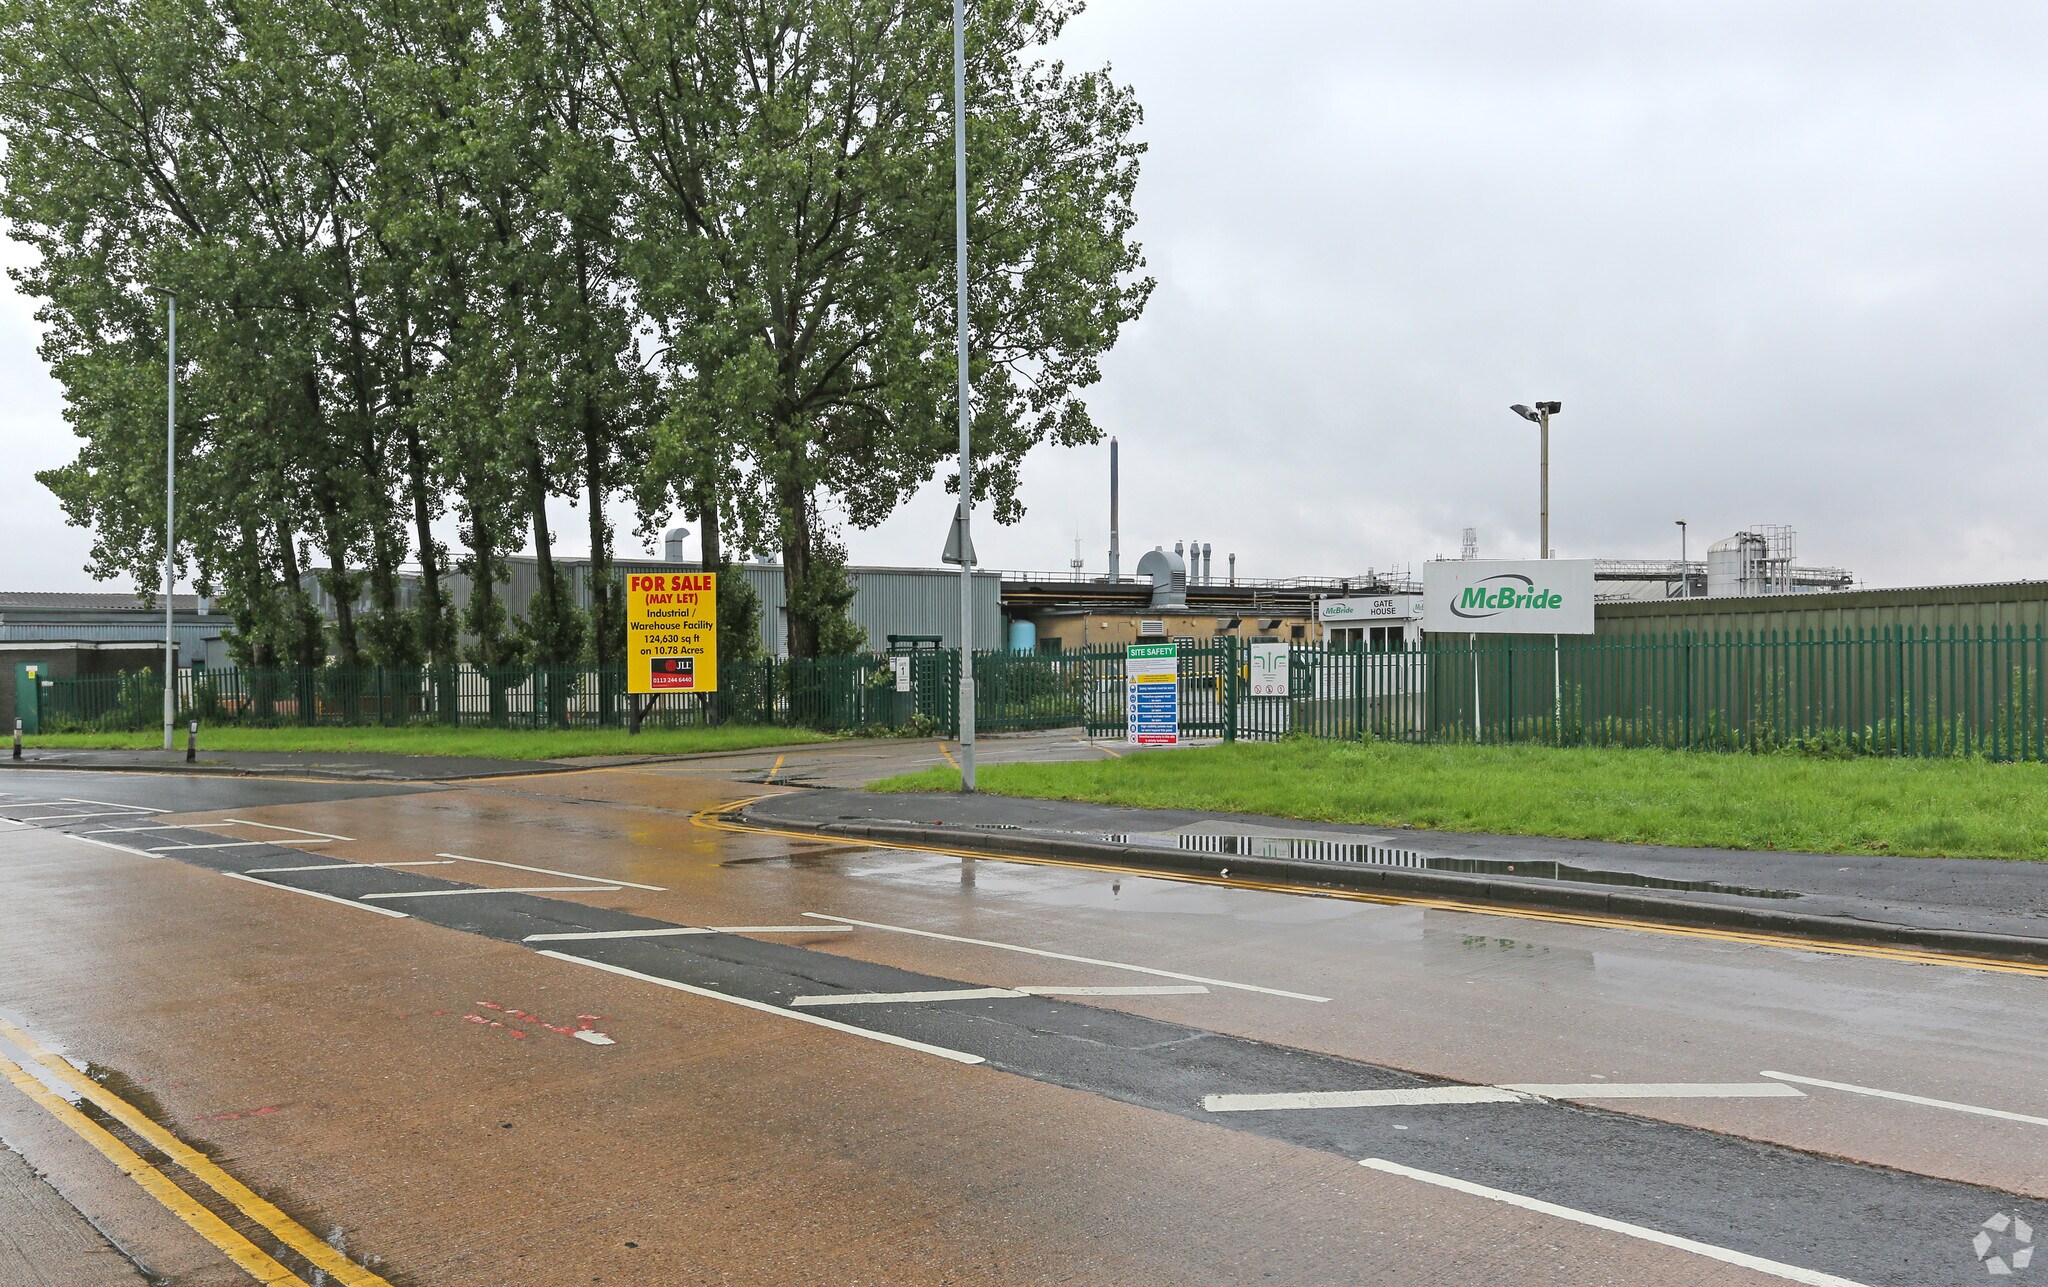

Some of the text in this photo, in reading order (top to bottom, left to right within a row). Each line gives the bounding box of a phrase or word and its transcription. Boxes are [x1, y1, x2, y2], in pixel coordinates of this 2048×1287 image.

[632, 576, 711, 591] FOR SALE
[646, 593, 698, 606] (MAY LET)
[1460, 586, 1562, 609] McBride
[647, 608, 696, 617] Industrial /
[631, 621, 713, 631] Warehouse Facility
[644, 635, 678, 644] 124,630
[694, 634, 700, 642] ft
[655, 646, 678, 654] 10.78
[1147, 648, 1173, 656] SAFETY
[677, 661, 691, 669] JLL
